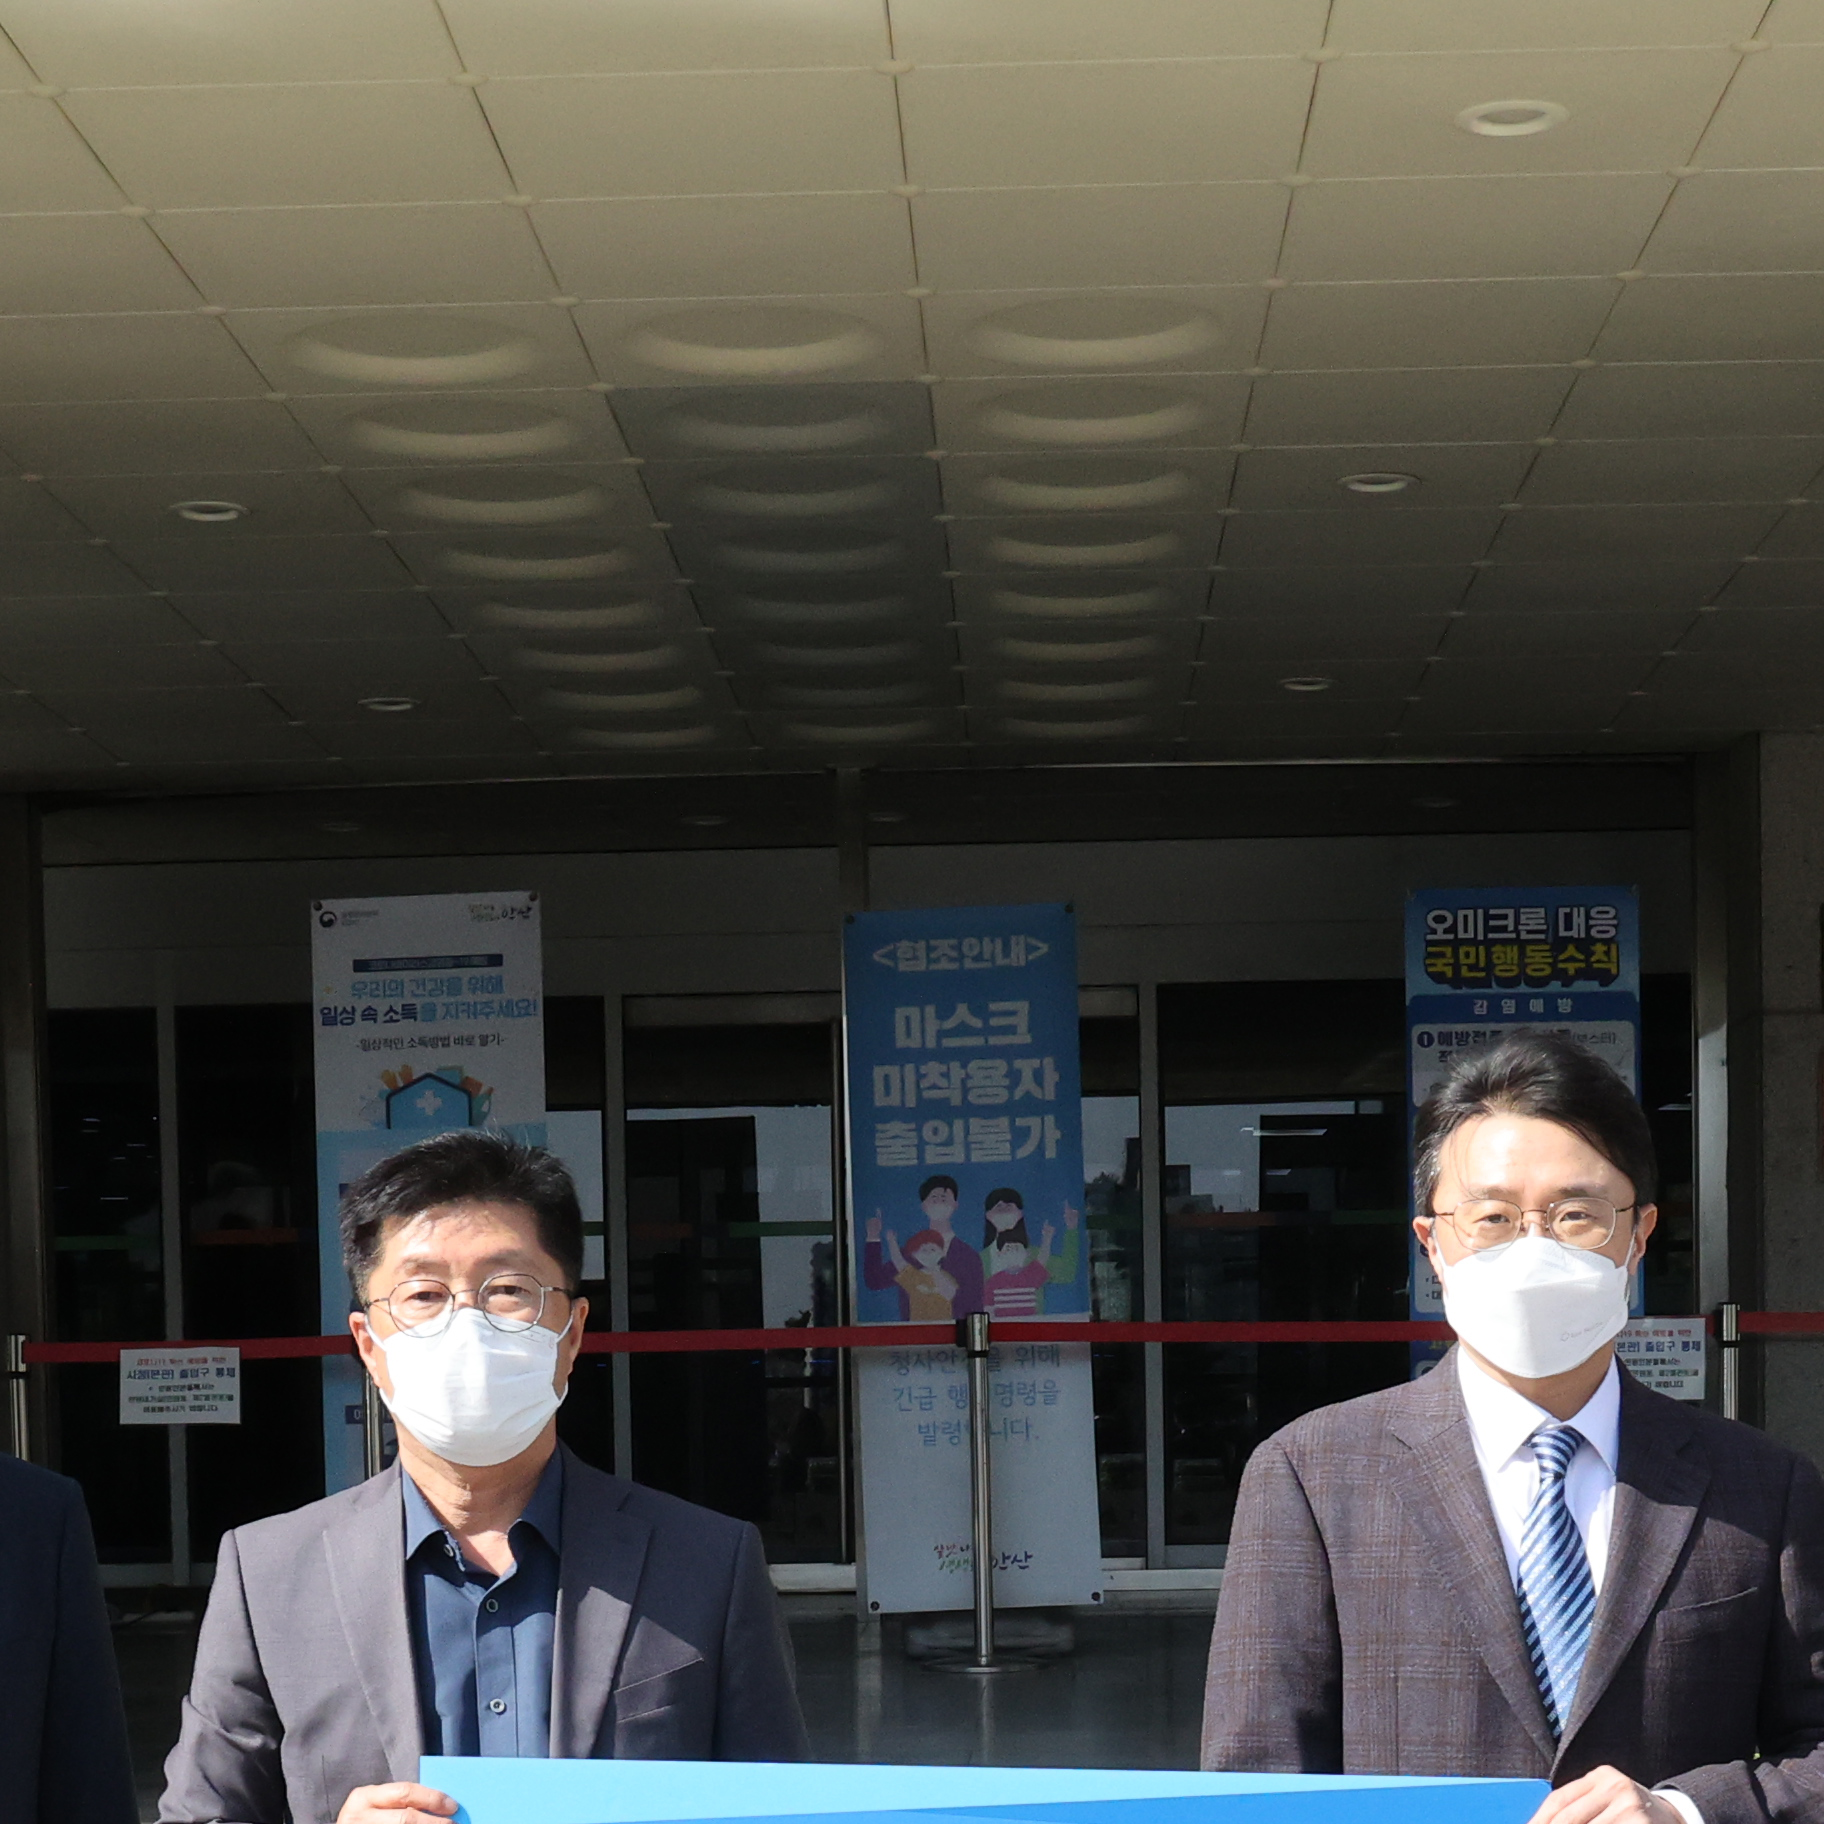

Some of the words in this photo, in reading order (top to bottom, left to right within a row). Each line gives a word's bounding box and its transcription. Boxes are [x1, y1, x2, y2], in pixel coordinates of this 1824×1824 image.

[1426, 907, 1547, 941] 오미크론
[1558, 905, 1618, 939] 대응
[1426, 943, 1618, 978] 국민행동수칙
[409, 977, 463, 997] 건강을
[468, 975, 504, 995] 위해
[320, 1005, 356, 1026] 일상
[361, 1004, 378, 1023] 속
[383, 1002, 436, 1023] 소독을
[442, 999, 539, 1020] 지켜주세요!
[895, 1001, 1032, 1048] 마스크
[873, 1056, 1060, 1107] 미착용자
[875, 1114, 1062, 1167] 출입불가
[890, 1347, 1001, 1375] 청사안을
[1016, 1345, 1060, 1368] 위해
[894, 1386, 937, 1412] 긴급
[948, 1379, 1061, 1409] 행명령을
[918, 1418, 1039, 1447] 발령니다.
